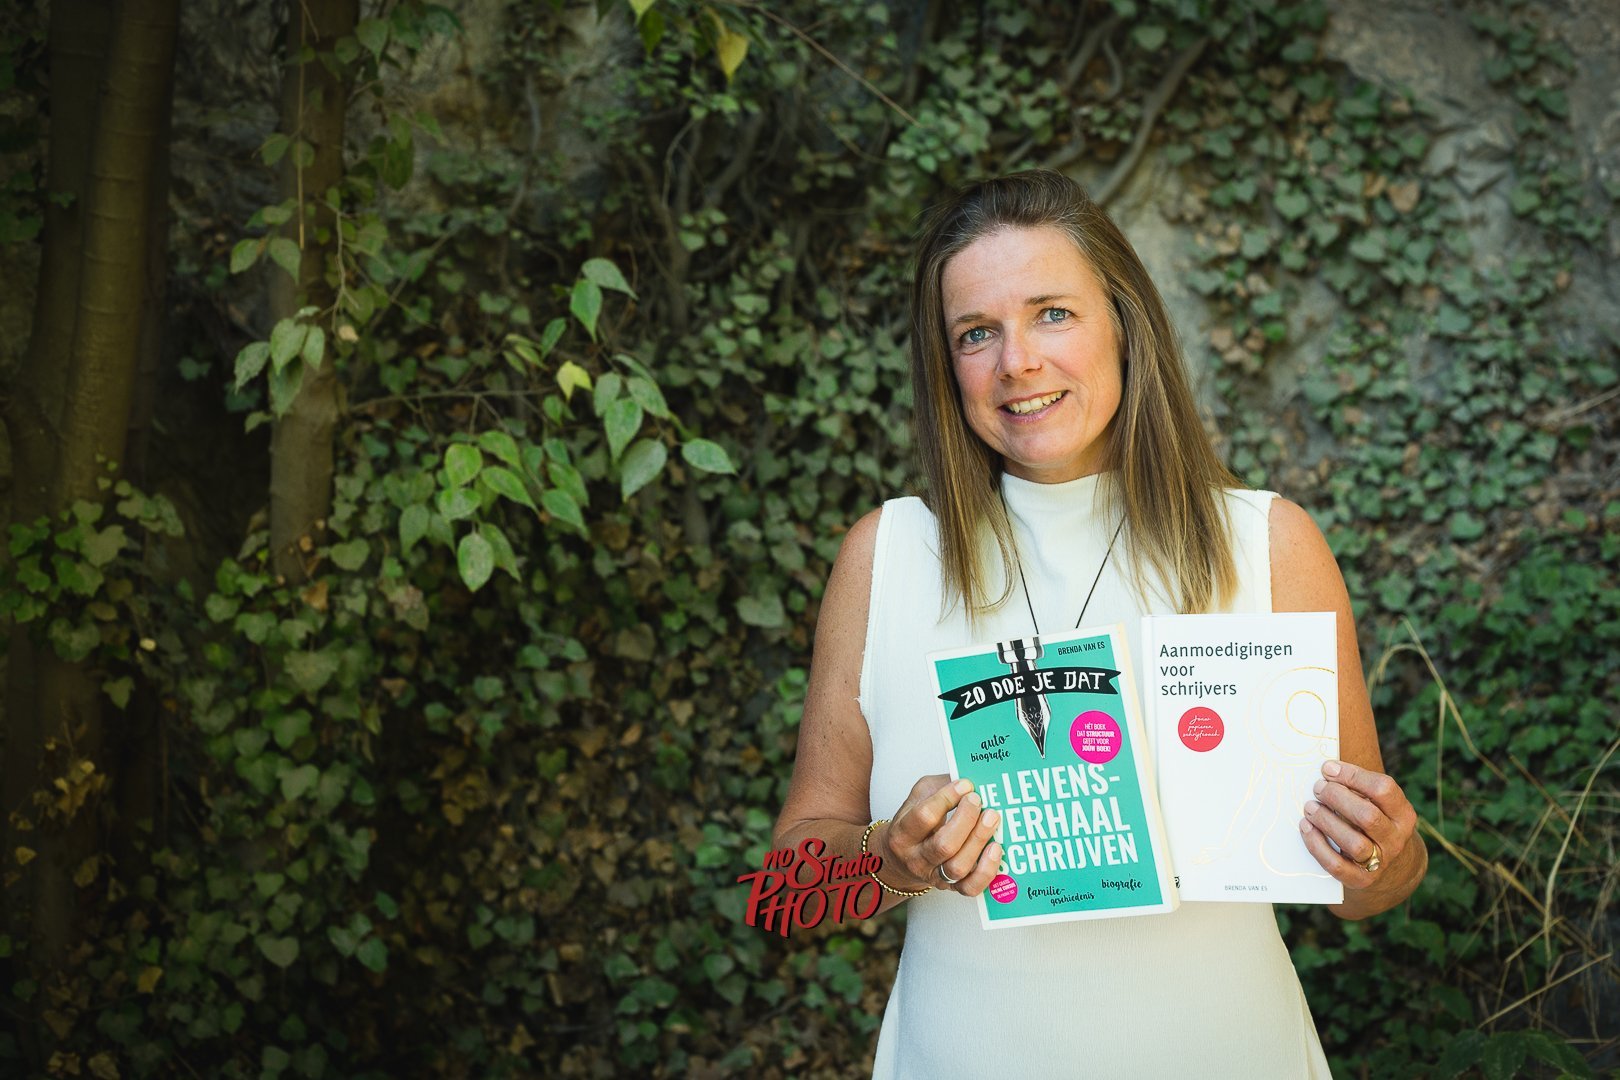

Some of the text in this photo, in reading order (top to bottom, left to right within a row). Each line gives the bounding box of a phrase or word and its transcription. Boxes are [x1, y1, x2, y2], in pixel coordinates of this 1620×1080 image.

[1058, 641, 1106, 656] BRENDA VAN ES
[1160, 642, 1293, 660] Aanmoedigingen
[1160, 664, 1195, 676] voor
[961, 671, 1106, 710] ZO DOE JE DAT
[1161, 682, 1237, 698] schrijvers
[980, 734, 1012, 750] auto-
[971, 748, 1011, 762] biografie
[1002, 764, 1120, 804] LEVENS-
[1101, 877, 1143, 890] biografie
[1027, 885, 1066, 900] familie-
[1050, 891, 1095, 906] geschiedenis
